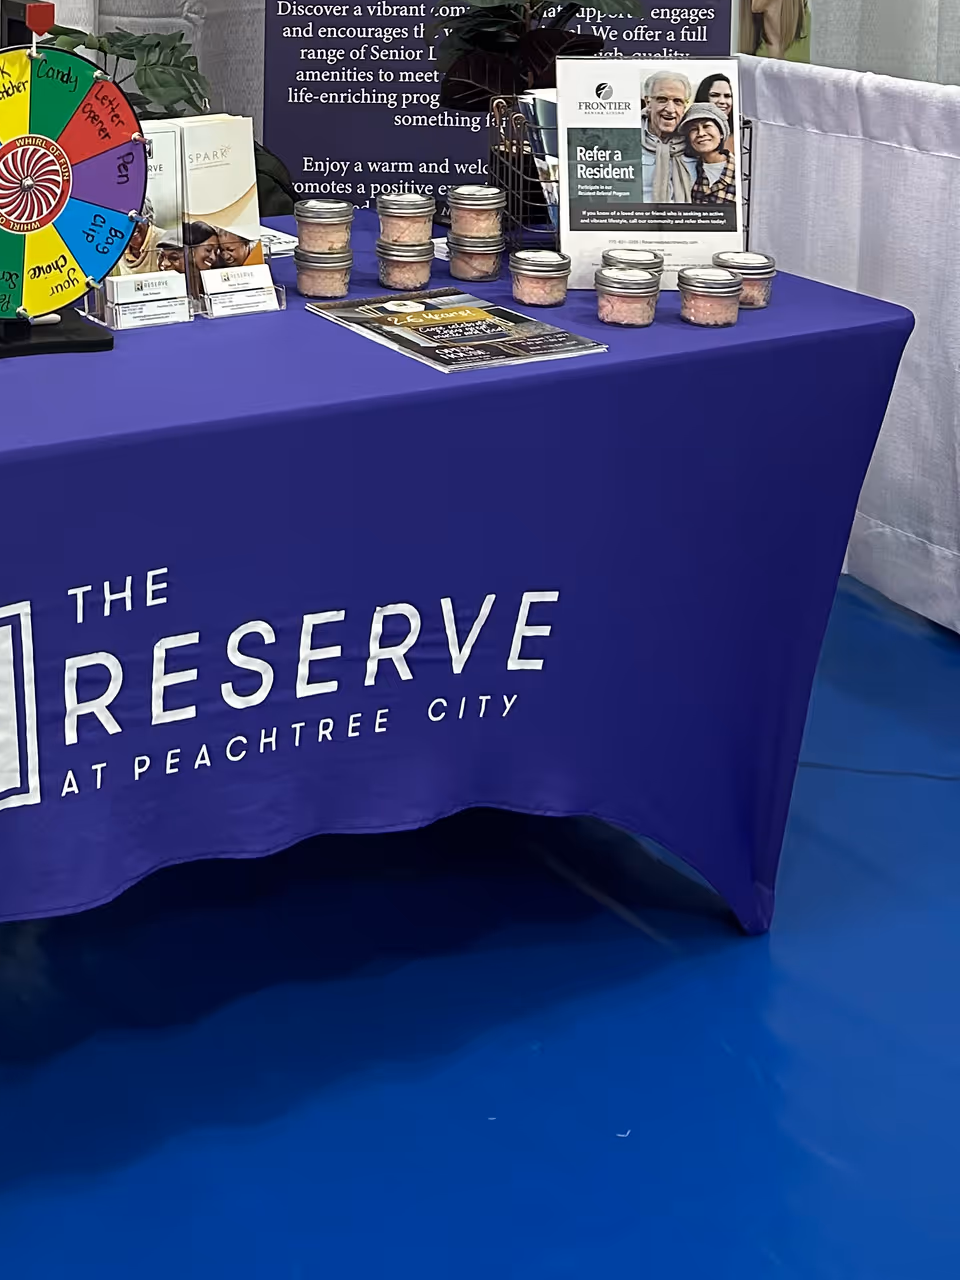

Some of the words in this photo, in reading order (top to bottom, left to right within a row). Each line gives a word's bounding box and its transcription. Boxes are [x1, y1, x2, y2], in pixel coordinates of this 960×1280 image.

[277, 0, 350, 17] Discover
[353, 5, 362, 17] a
[367, 0, 426, 17] vibrant
[650, 6, 716, 24] engages
[282, 22, 314, 38] and
[318, 25, 409, 43] encourages
[591, 25, 618, 42] We
[622, 24, 662, 42] offer
[666, 30, 675, 41] a
[679, 24, 708, 42] full
[300, 48, 345, 65] range
[349, 44, 368, 60] of
[370, 45, 423, 61] Senior
[36, 59, 78, 92] Candy
[296, 67, 373, 82] amenities
[378, 69, 394, 82] to
[398, 69, 439, 83] meet
[94, 85, 125, 127] Letter
[288, 87, 397, 107] life-enriching
[401, 91, 440, 109] prog
[578, 101, 631, 110] FRONTIER
[394, 111, 481, 132] something
[16, 138, 47, 148] WHIRL
[49, 145, 61, 157] OF
[58, 158, 70, 180] FUN
[188, 148, 228, 163] SPARK
[576, 146, 611, 161] Refer
[614, 150, 622, 161] a
[116, 152, 135, 185] Pen
[302, 157, 350, 176] Enjoy
[354, 161, 363, 172] a
[367, 161, 414, 173] warm
[418, 158, 450, 174] and
[577, 164, 635, 179] Resident
[357, 182, 366, 194] a
[370, 180, 434, 197] positive
[9, 221, 41, 231] WHIRL
[95, 226, 125, 255] Bag
[67, 567, 170, 624] THE
[62, 590, 561, 746] RESERVE
[60, 762, 108, 797] AT
[133, 708, 390, 782] PEACHTREE
[427, 693, 520, 723] CITY
